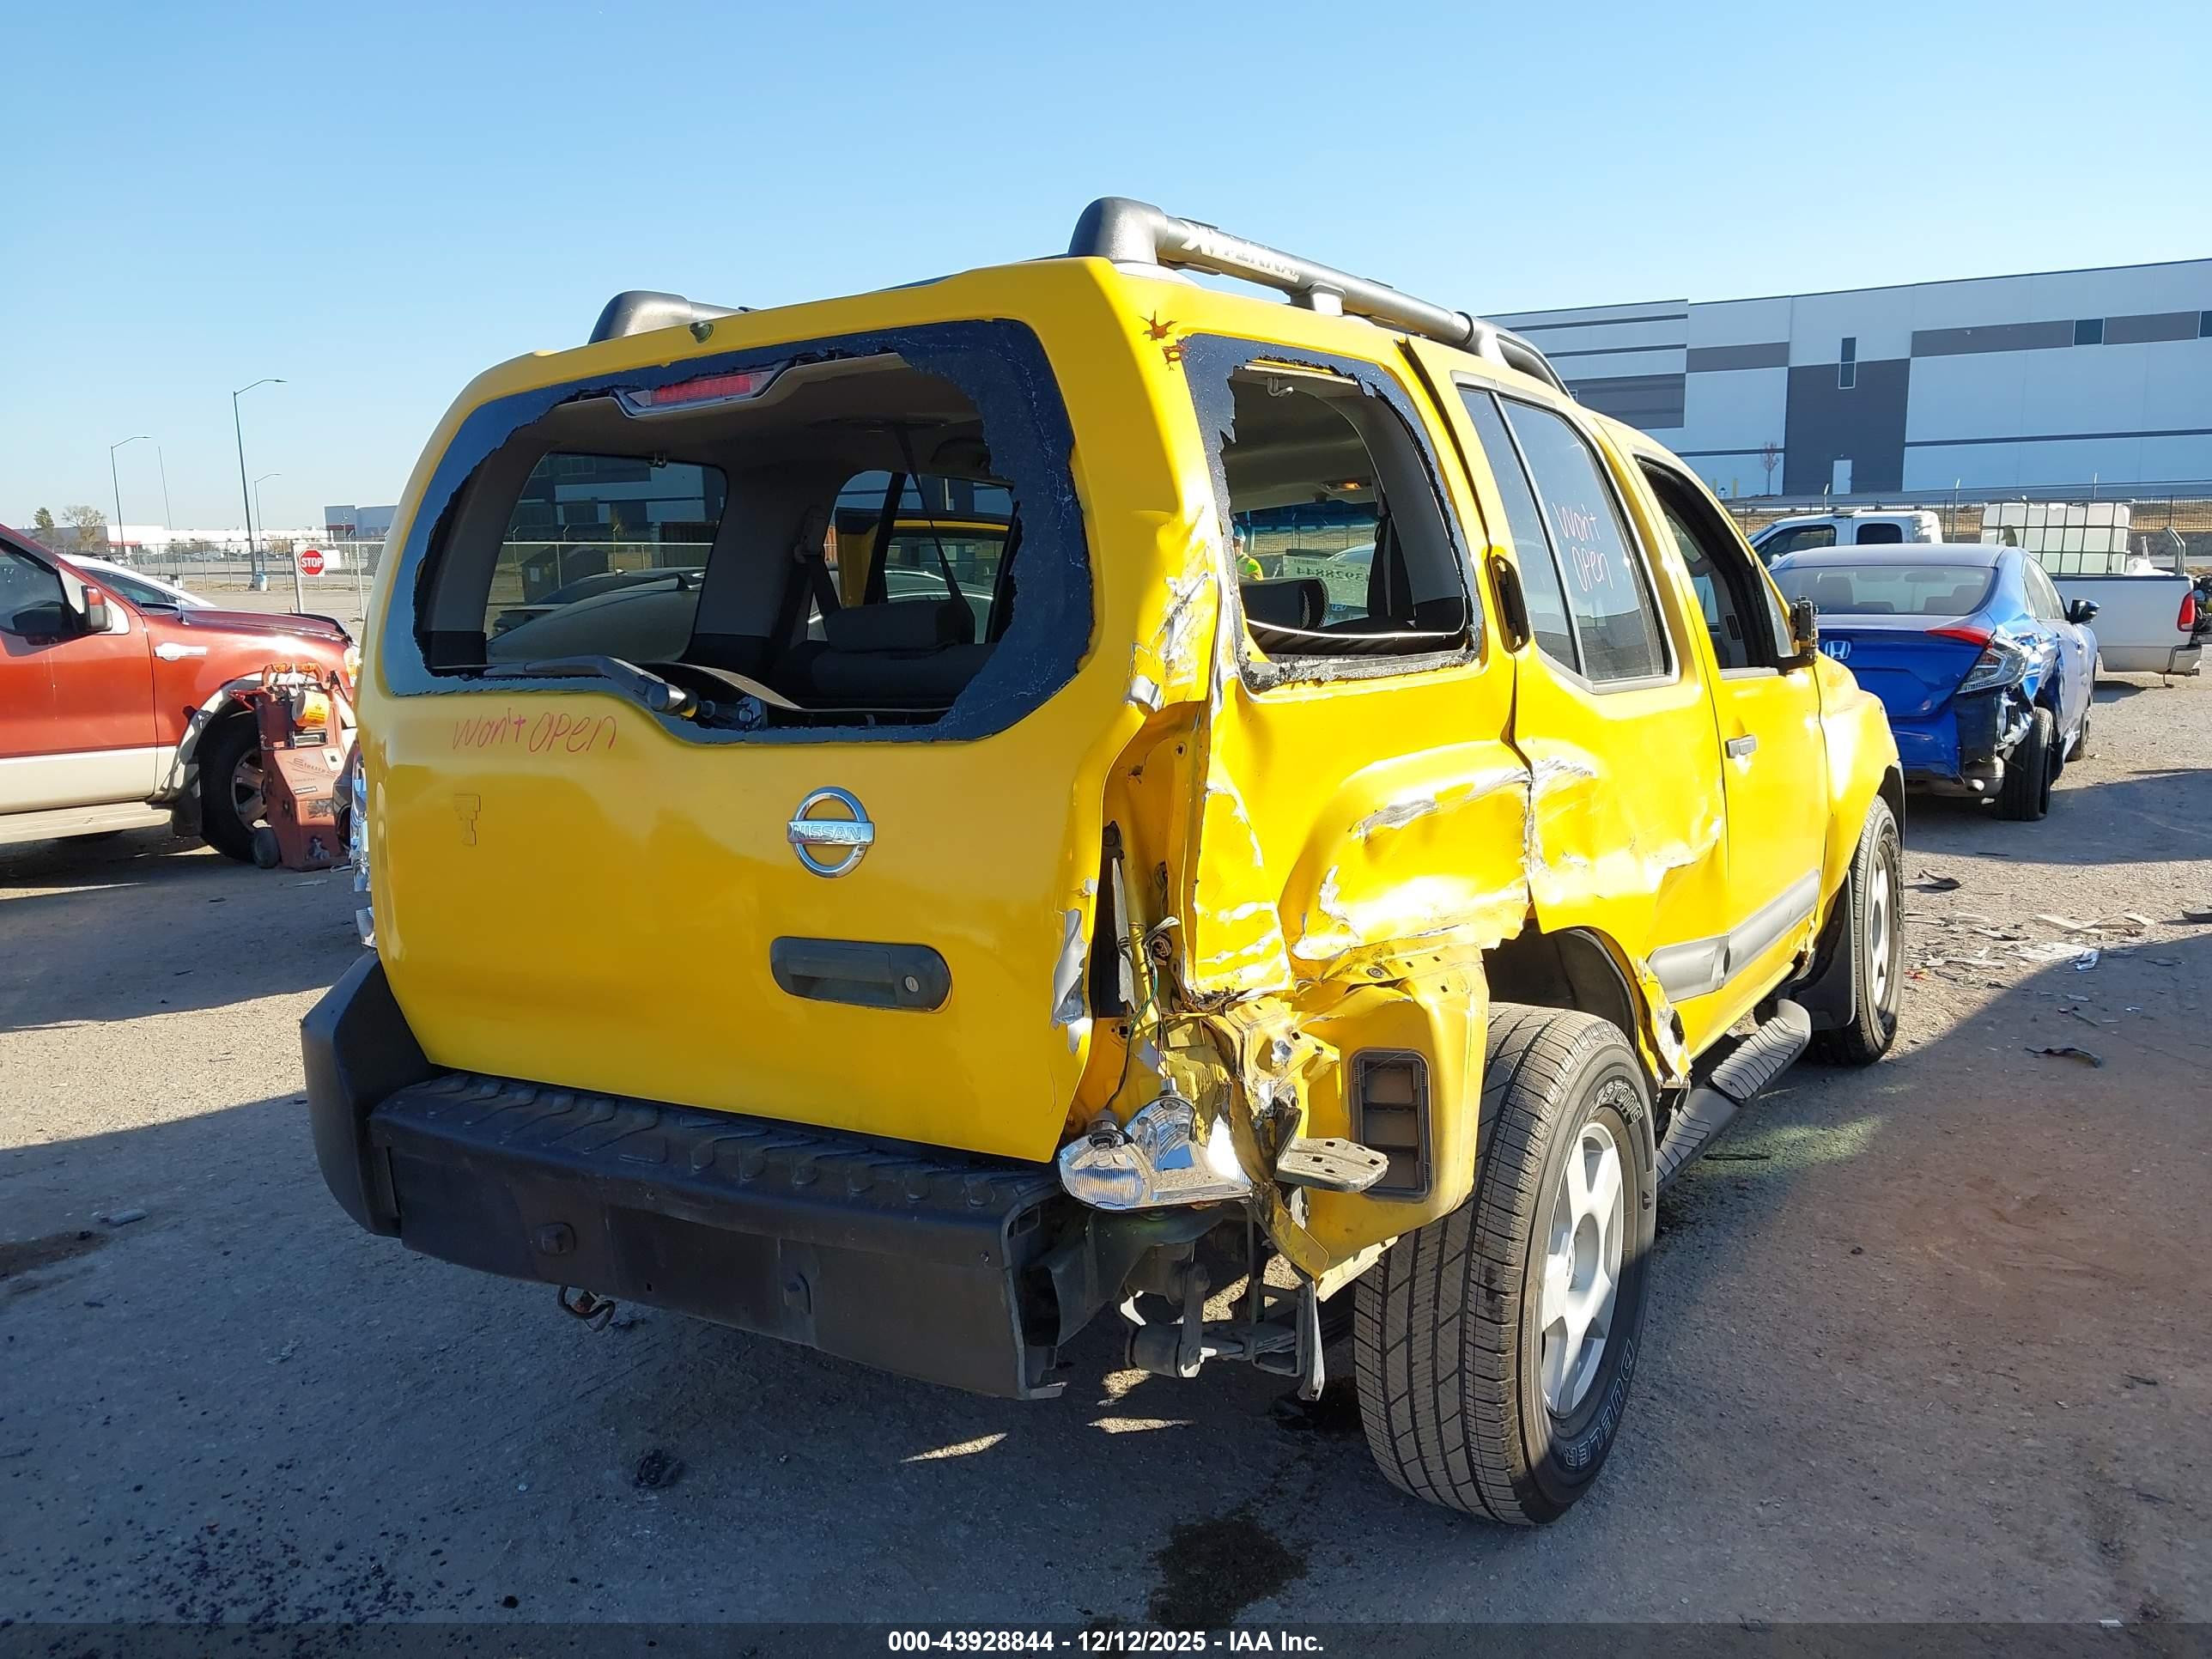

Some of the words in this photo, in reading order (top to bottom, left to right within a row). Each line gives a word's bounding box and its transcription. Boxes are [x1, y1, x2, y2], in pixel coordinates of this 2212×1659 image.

[301, 556, 323, 568] STOP
[792, 824, 862, 841] NISSAN
[1565, 1339, 1635, 1468] DUELER
